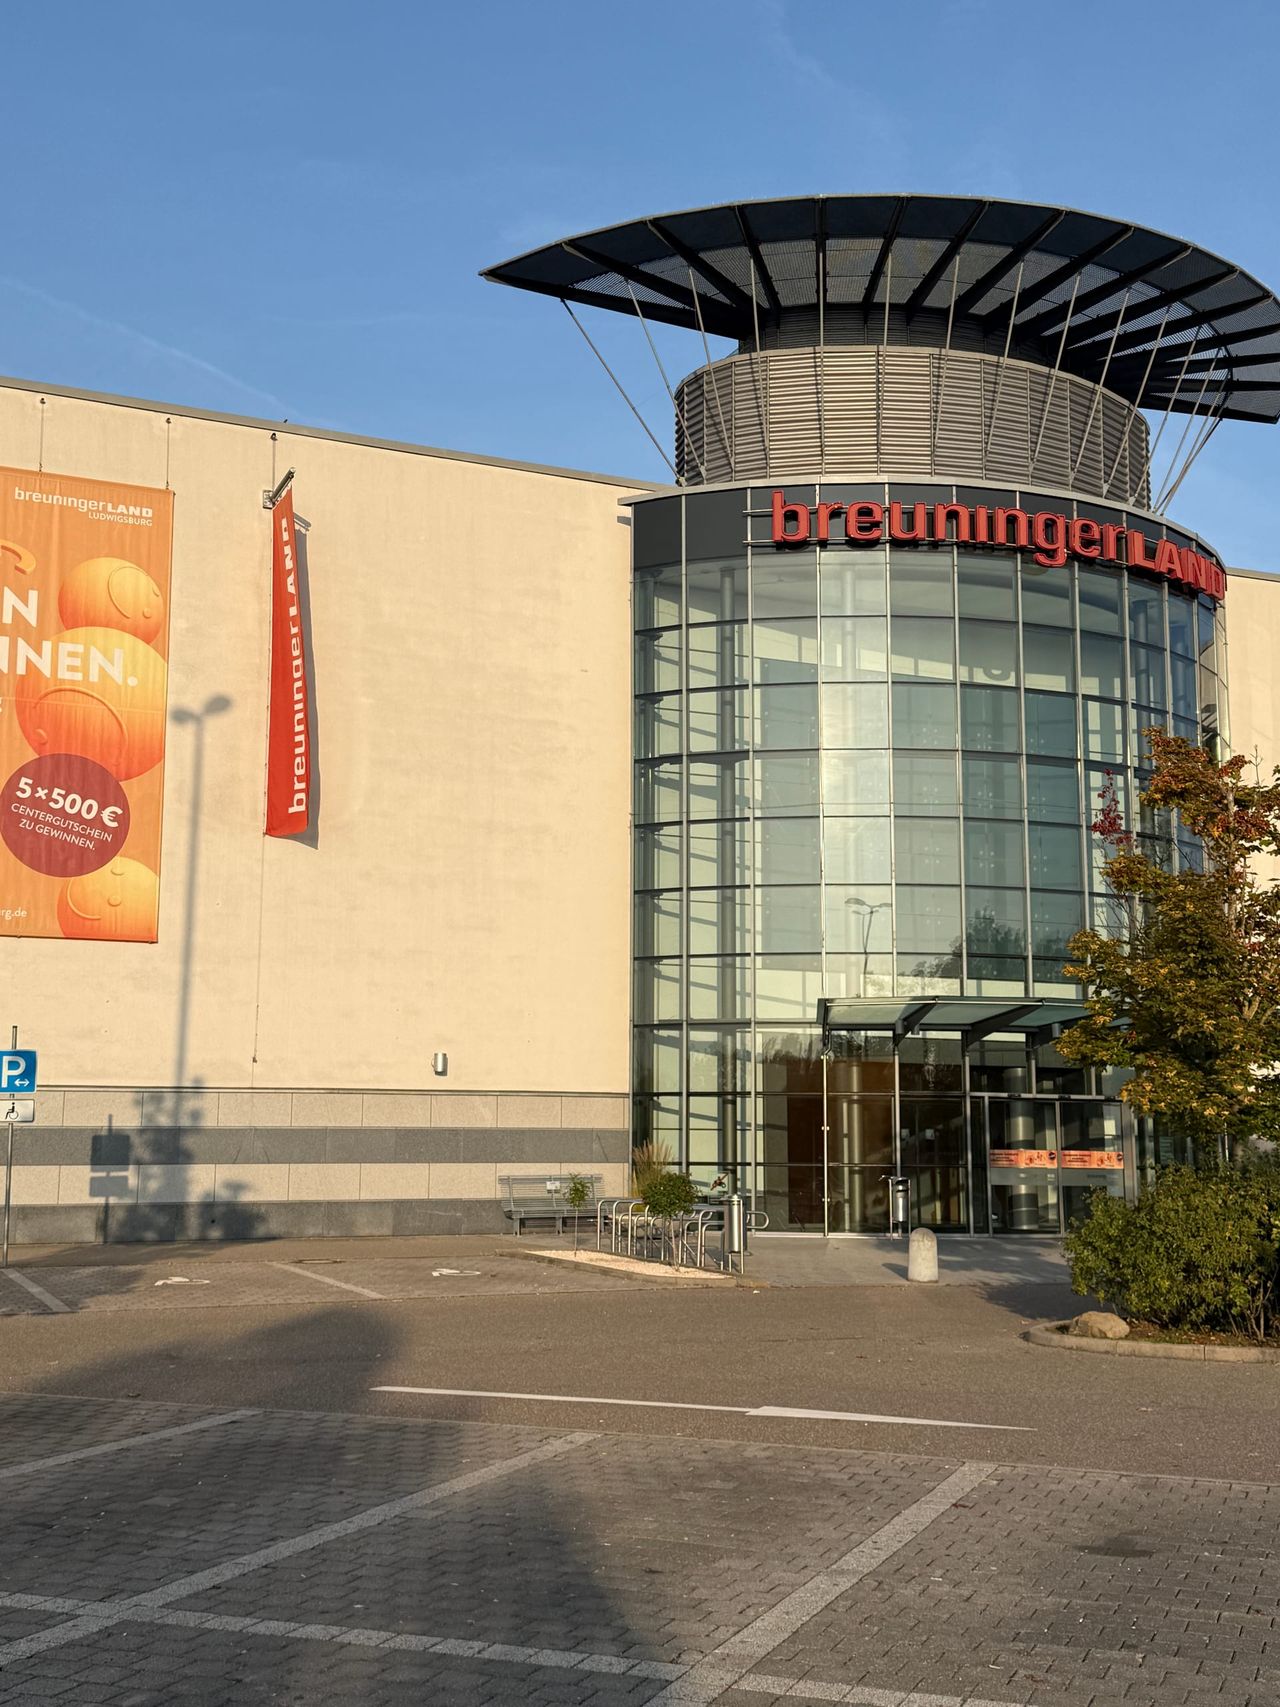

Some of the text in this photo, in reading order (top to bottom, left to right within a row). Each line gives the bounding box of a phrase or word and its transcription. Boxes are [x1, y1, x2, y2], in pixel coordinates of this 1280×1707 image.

[14, 486, 153, 518] breuningerLAND
[88, 511, 153, 527] LUDWIGSBURG
[771, 489, 1226, 600] breuningerLAND
[0, 635, 138, 687] NEN.
[11, 803, 113, 843] CENTERGUTSCHEIN
[19, 818, 96, 851] ZU GEWINNEN.
[2, 1055, 26, 1088] P
